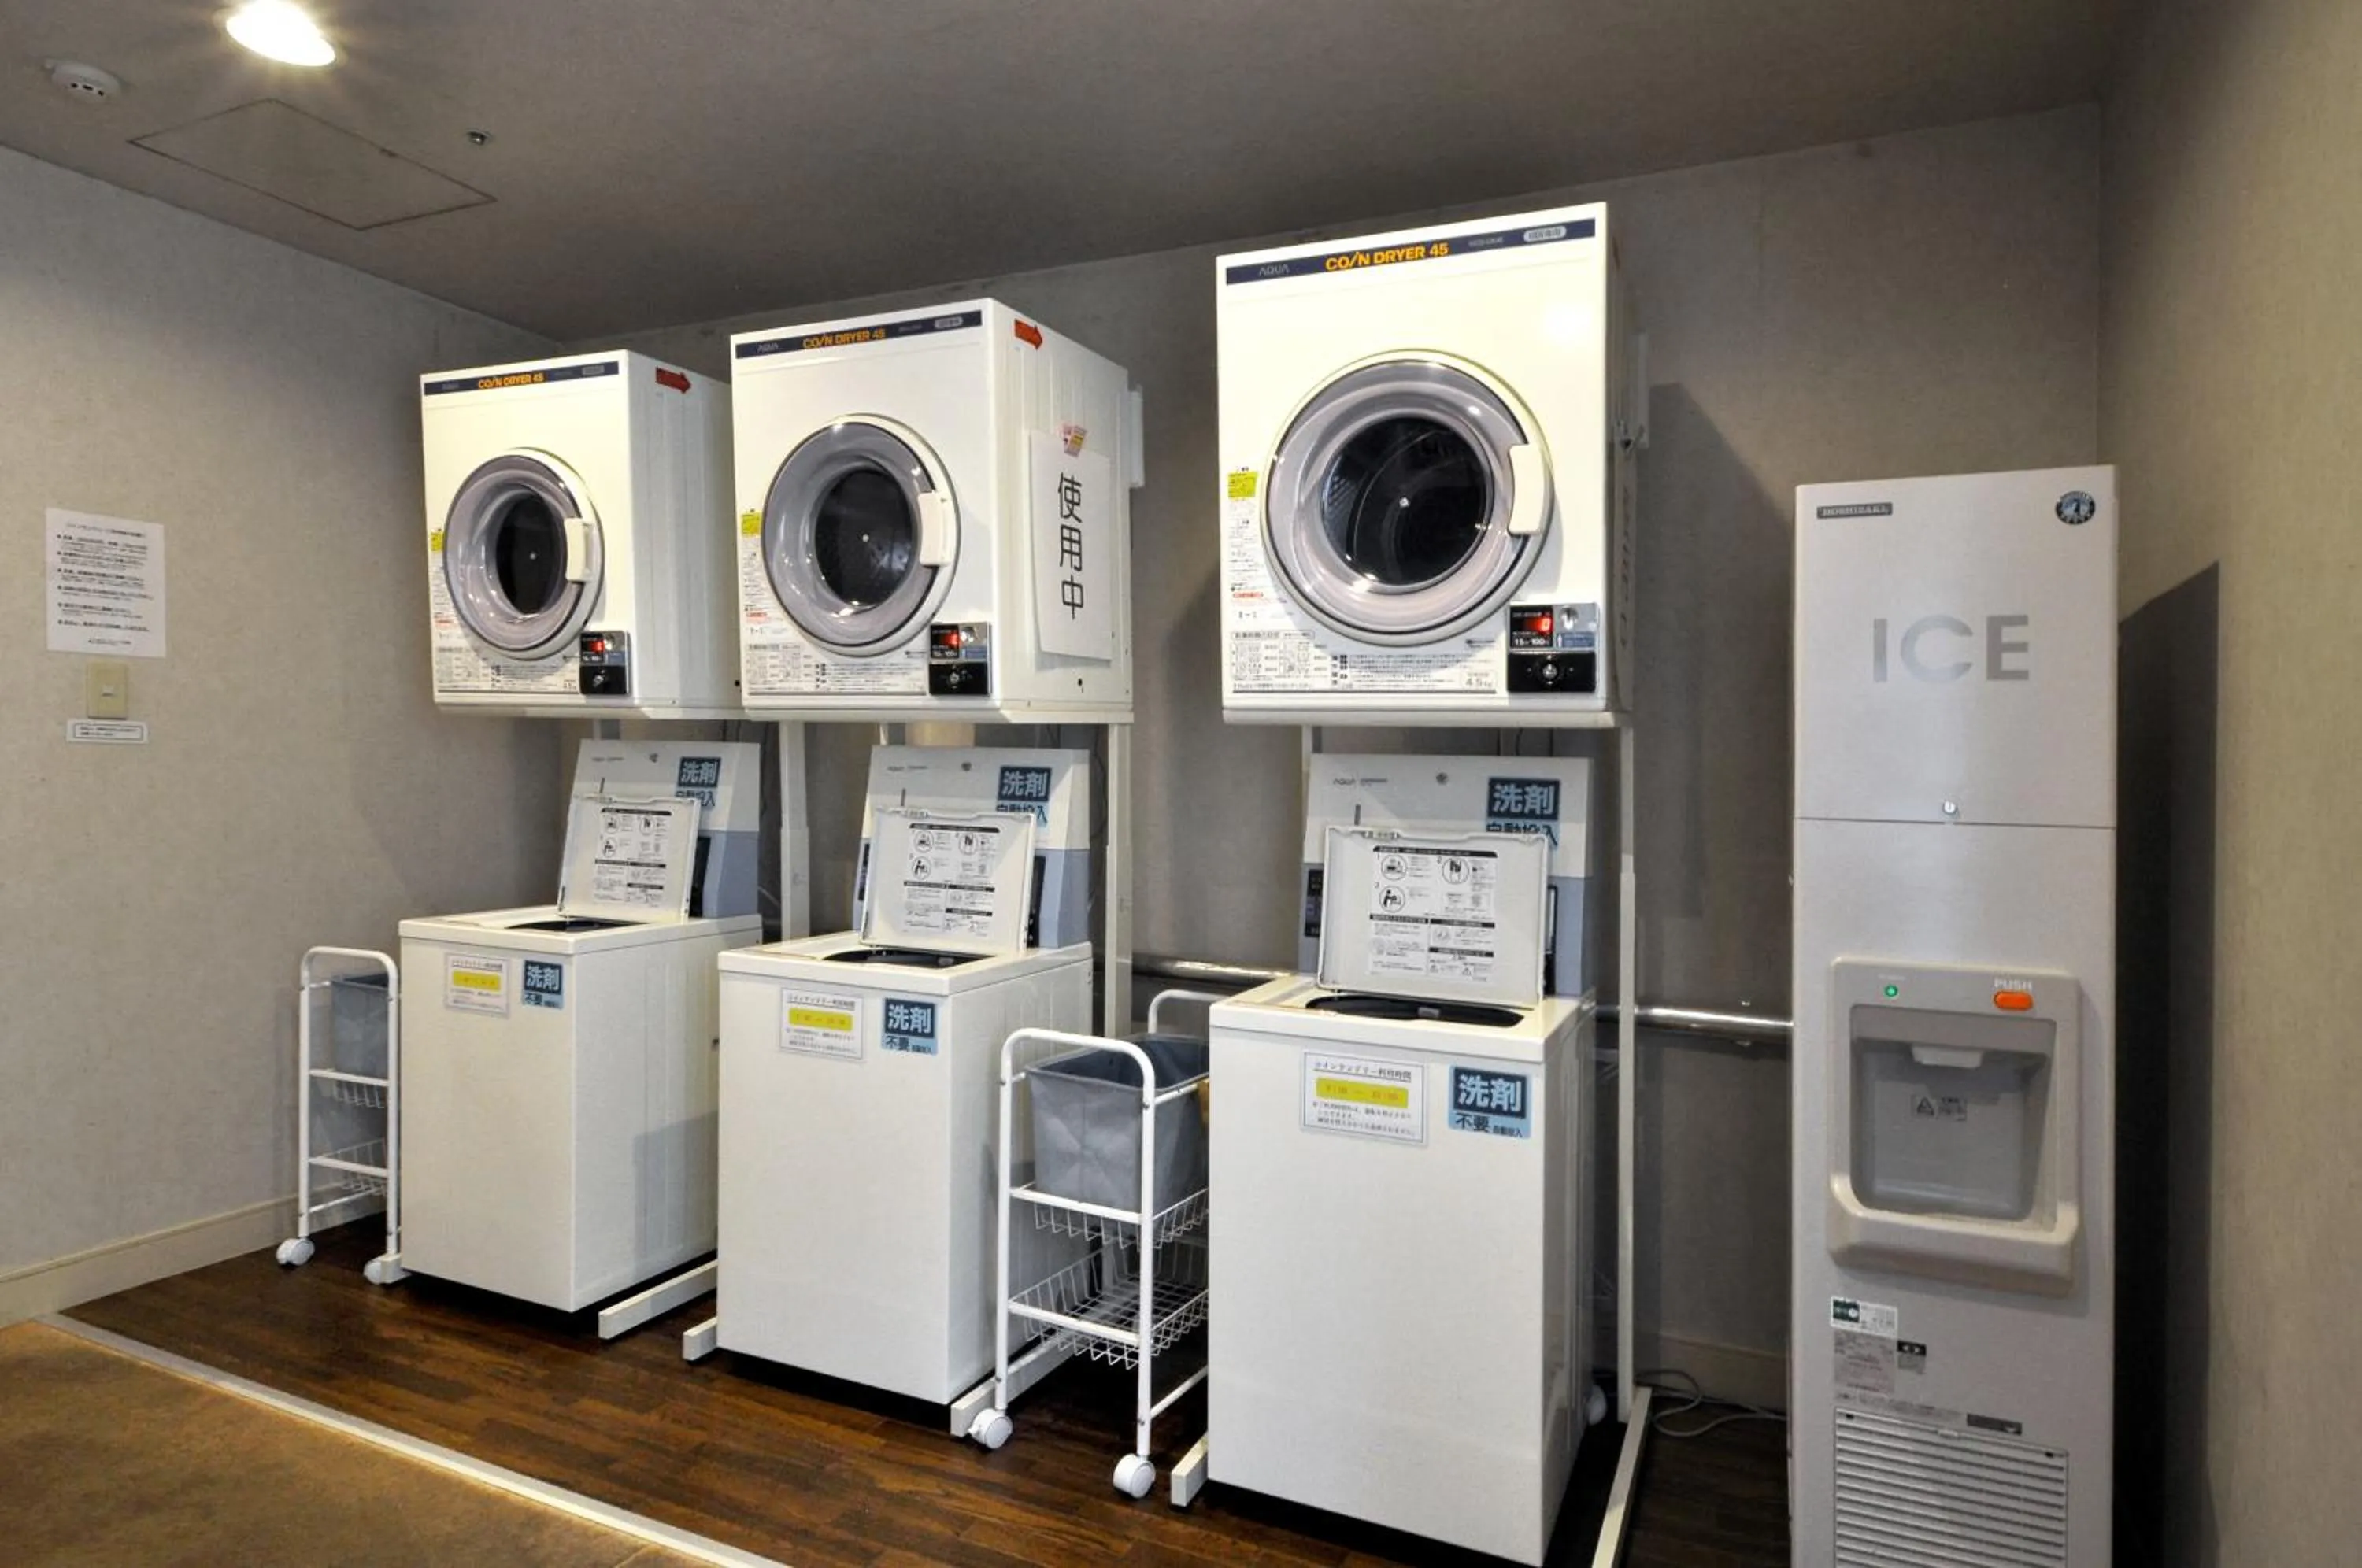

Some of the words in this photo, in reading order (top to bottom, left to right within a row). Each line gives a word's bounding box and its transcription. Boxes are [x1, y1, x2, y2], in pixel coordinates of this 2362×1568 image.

[1373, 244, 1425, 264] DRYER
[1430, 242, 1449, 257] 45
[835, 329, 870, 346] DRYER
[1058, 472, 1084, 620] 使用中
[1873, 614, 2029, 683] ICE
[1001, 771, 1049, 797] 洗剤
[1493, 784, 1555, 815] 洗剤
[527, 965, 560, 990] 洗剤
[1994, 978, 2032, 990] PUSH
[888, 1004, 931, 1034] 洗剤
[1458, 1074, 1522, 1112] 洗剤
[1455, 1112, 1489, 1133] 不要
